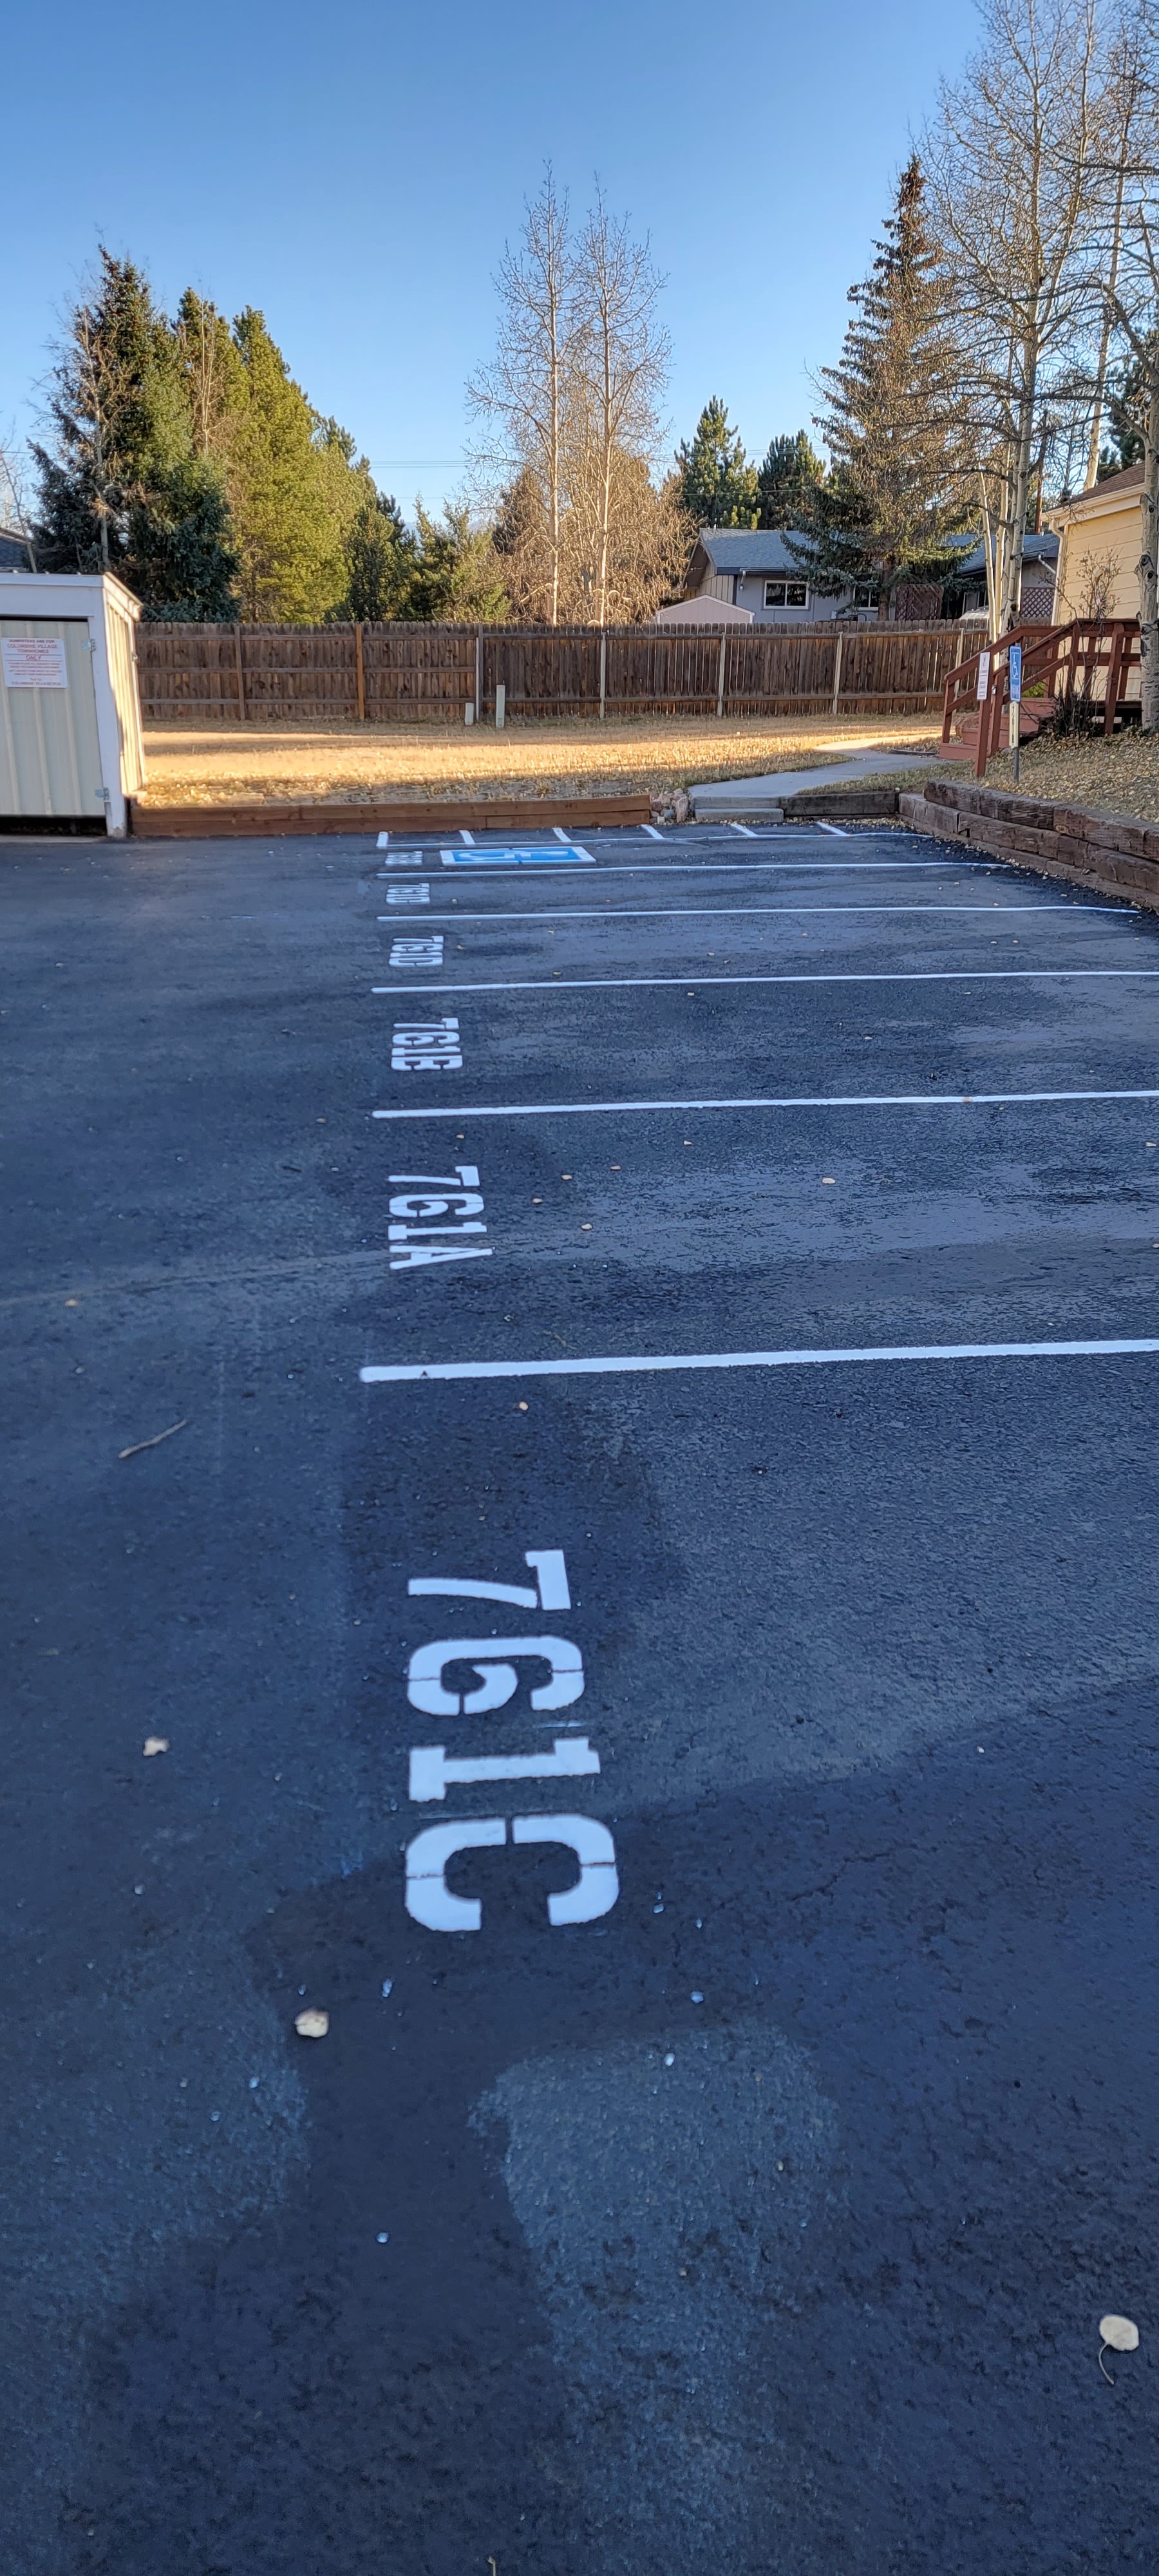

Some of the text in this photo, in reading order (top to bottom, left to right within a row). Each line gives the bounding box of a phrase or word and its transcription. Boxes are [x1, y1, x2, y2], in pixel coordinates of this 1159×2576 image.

[388, 935, 444, 967] 761D
[391, 1018, 463, 1071] 761E
[388, 1166, 493, 1270] 761A
[406, 1548, 619, 1932] 761C
